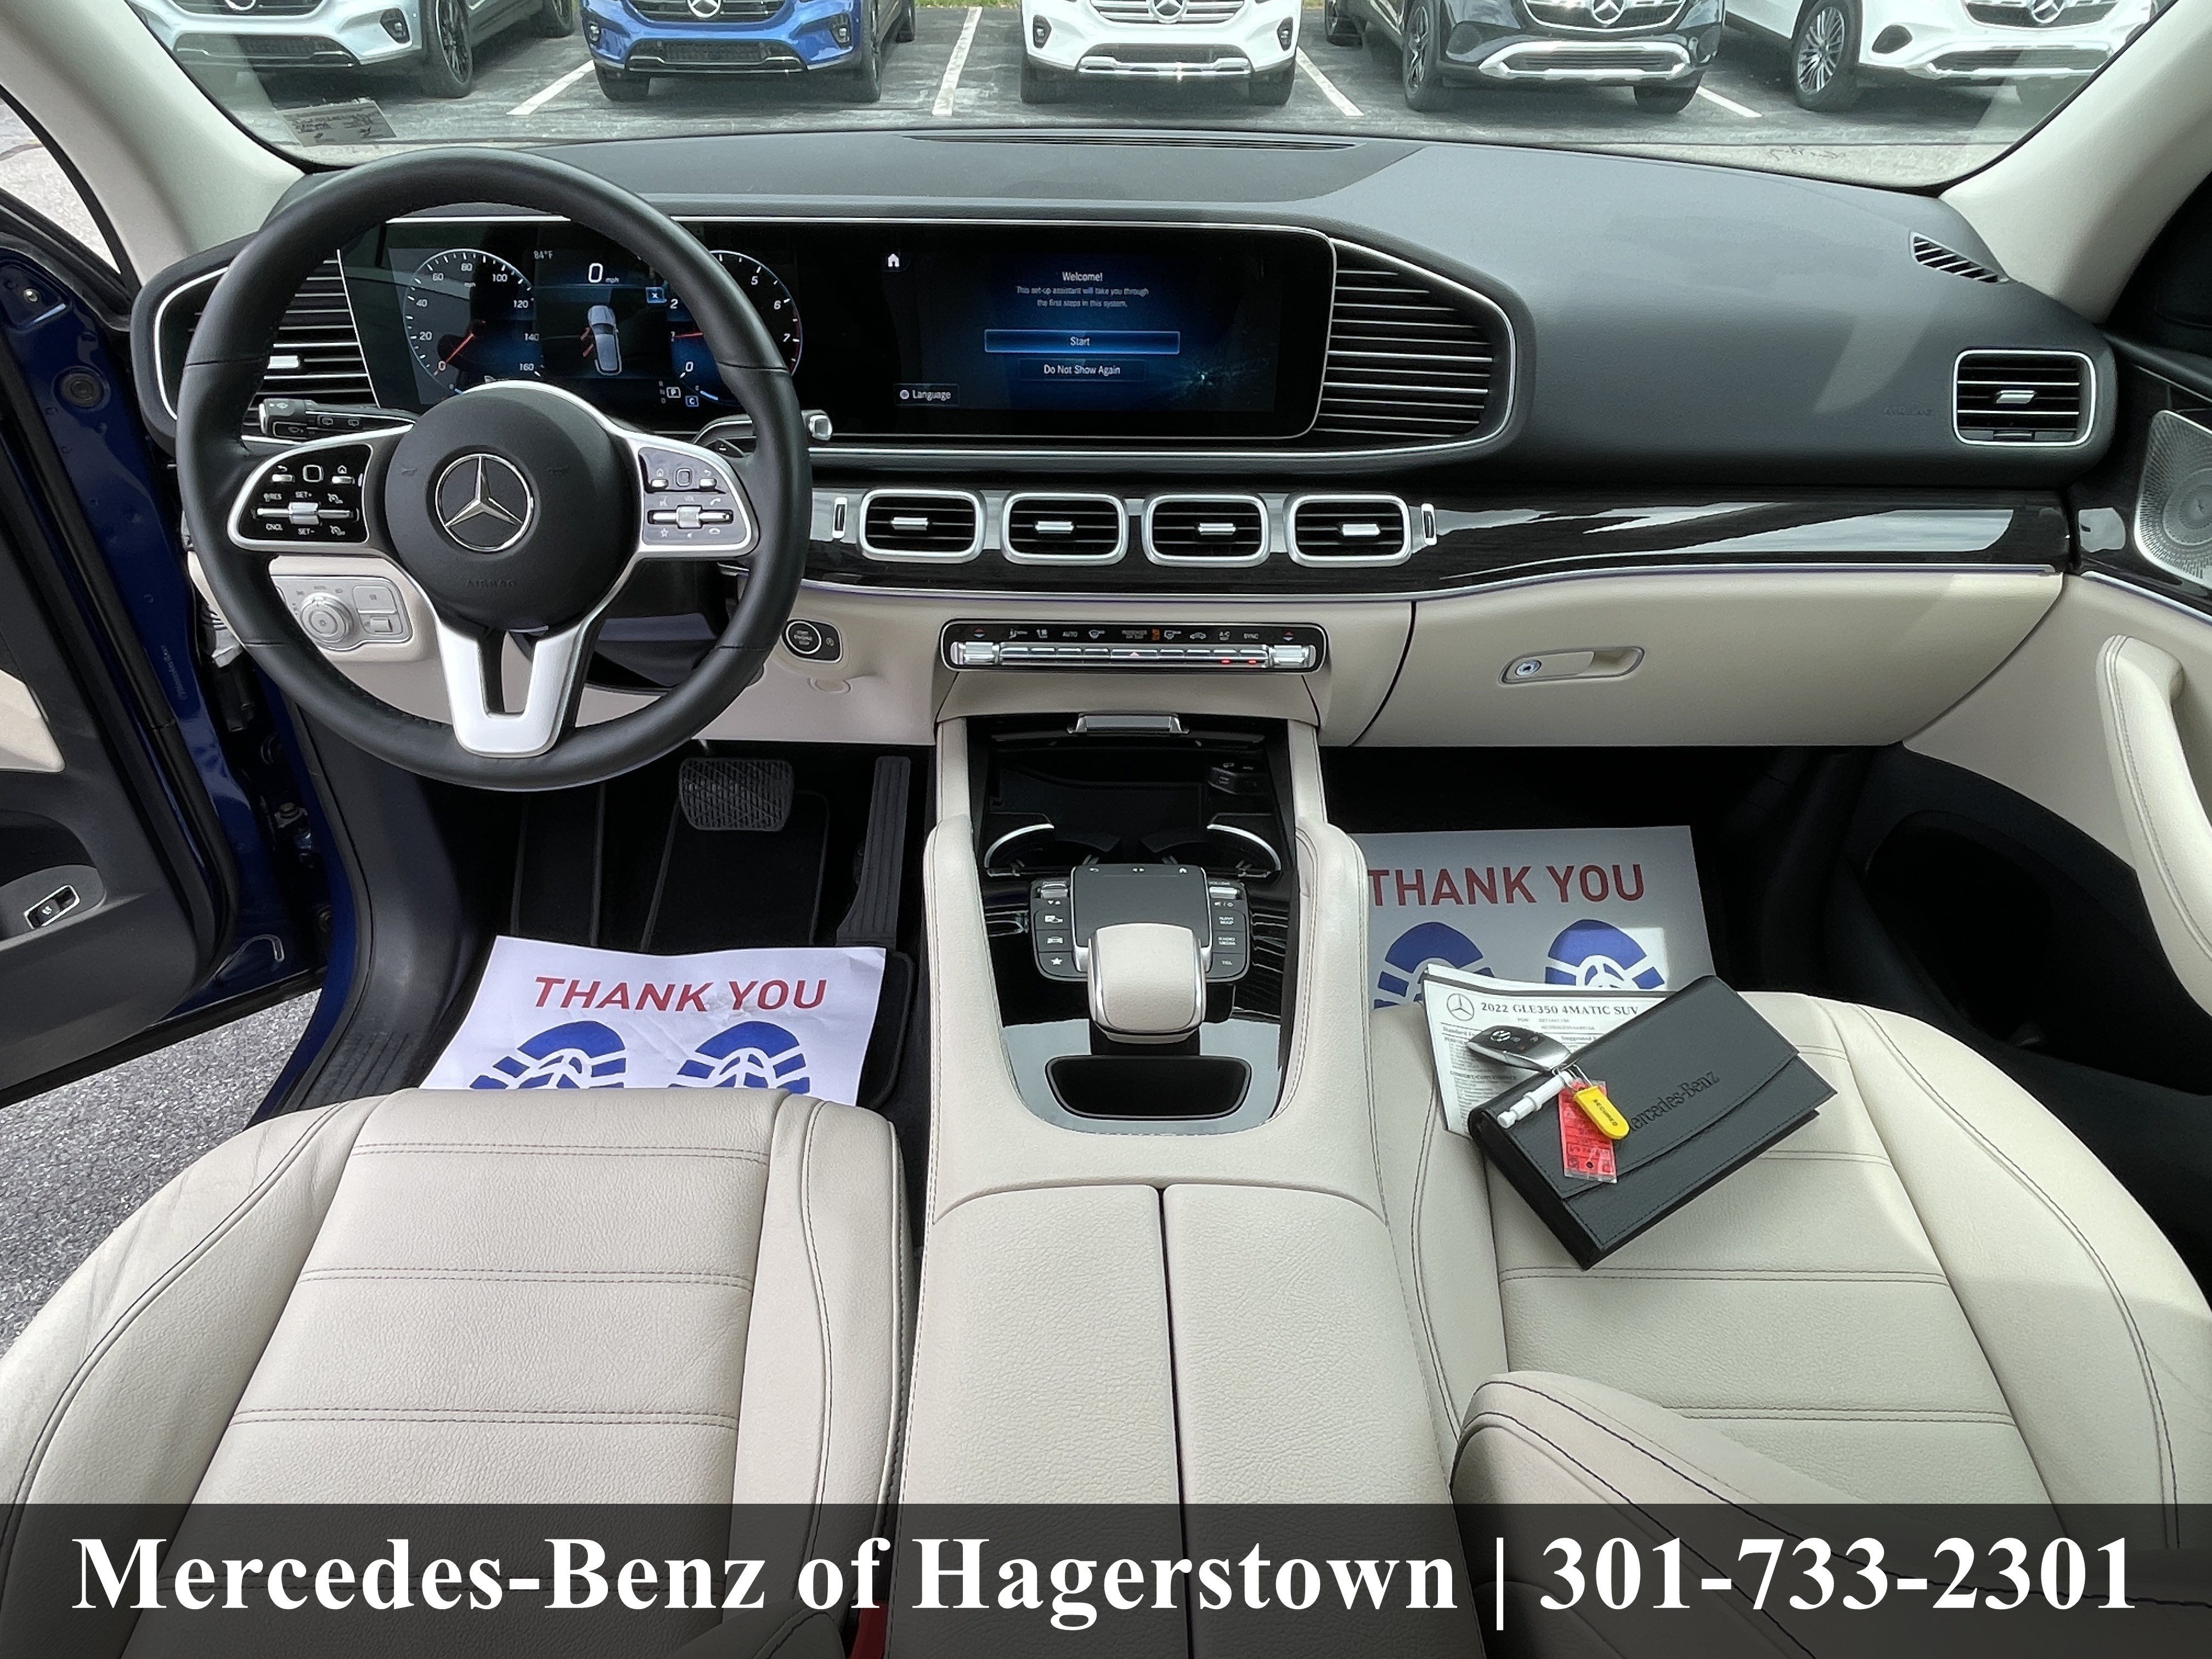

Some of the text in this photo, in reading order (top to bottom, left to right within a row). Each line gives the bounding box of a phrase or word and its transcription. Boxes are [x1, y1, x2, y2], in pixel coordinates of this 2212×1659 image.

[461, 263, 473, 271] 80
[432, 273, 444, 281] 60
[493, 274, 508, 282] 100
[588, 263, 603, 283] 0
[1062, 272, 1103, 281] Welcome!
[751, 276, 758, 285] 5
[1124, 288, 1149, 297] through
[416, 299, 428, 307] 40
[670, 299, 678, 309] 2
[774, 301, 781, 309] 6
[419, 331, 432, 341] 20
[524, 333, 539, 341] 140
[783, 333, 791, 342] 7
[1070, 336, 1090, 346] Start
[438, 360, 447, 371] 0
[520, 363, 534, 371] 160
[686, 362, 693, 372] 0
[1043, 365, 1120, 376] Do Not Show Again
[912, 390, 951, 401] Language
[1368, 863, 1645, 907] THANK YOU
[535, 977, 827, 1012] THANK YOU
[1481, 1002, 1639, 1015] 2022 GLE350 4MATIC SUV
[1629, 1071, 1720, 1132] ercedes-Benz
